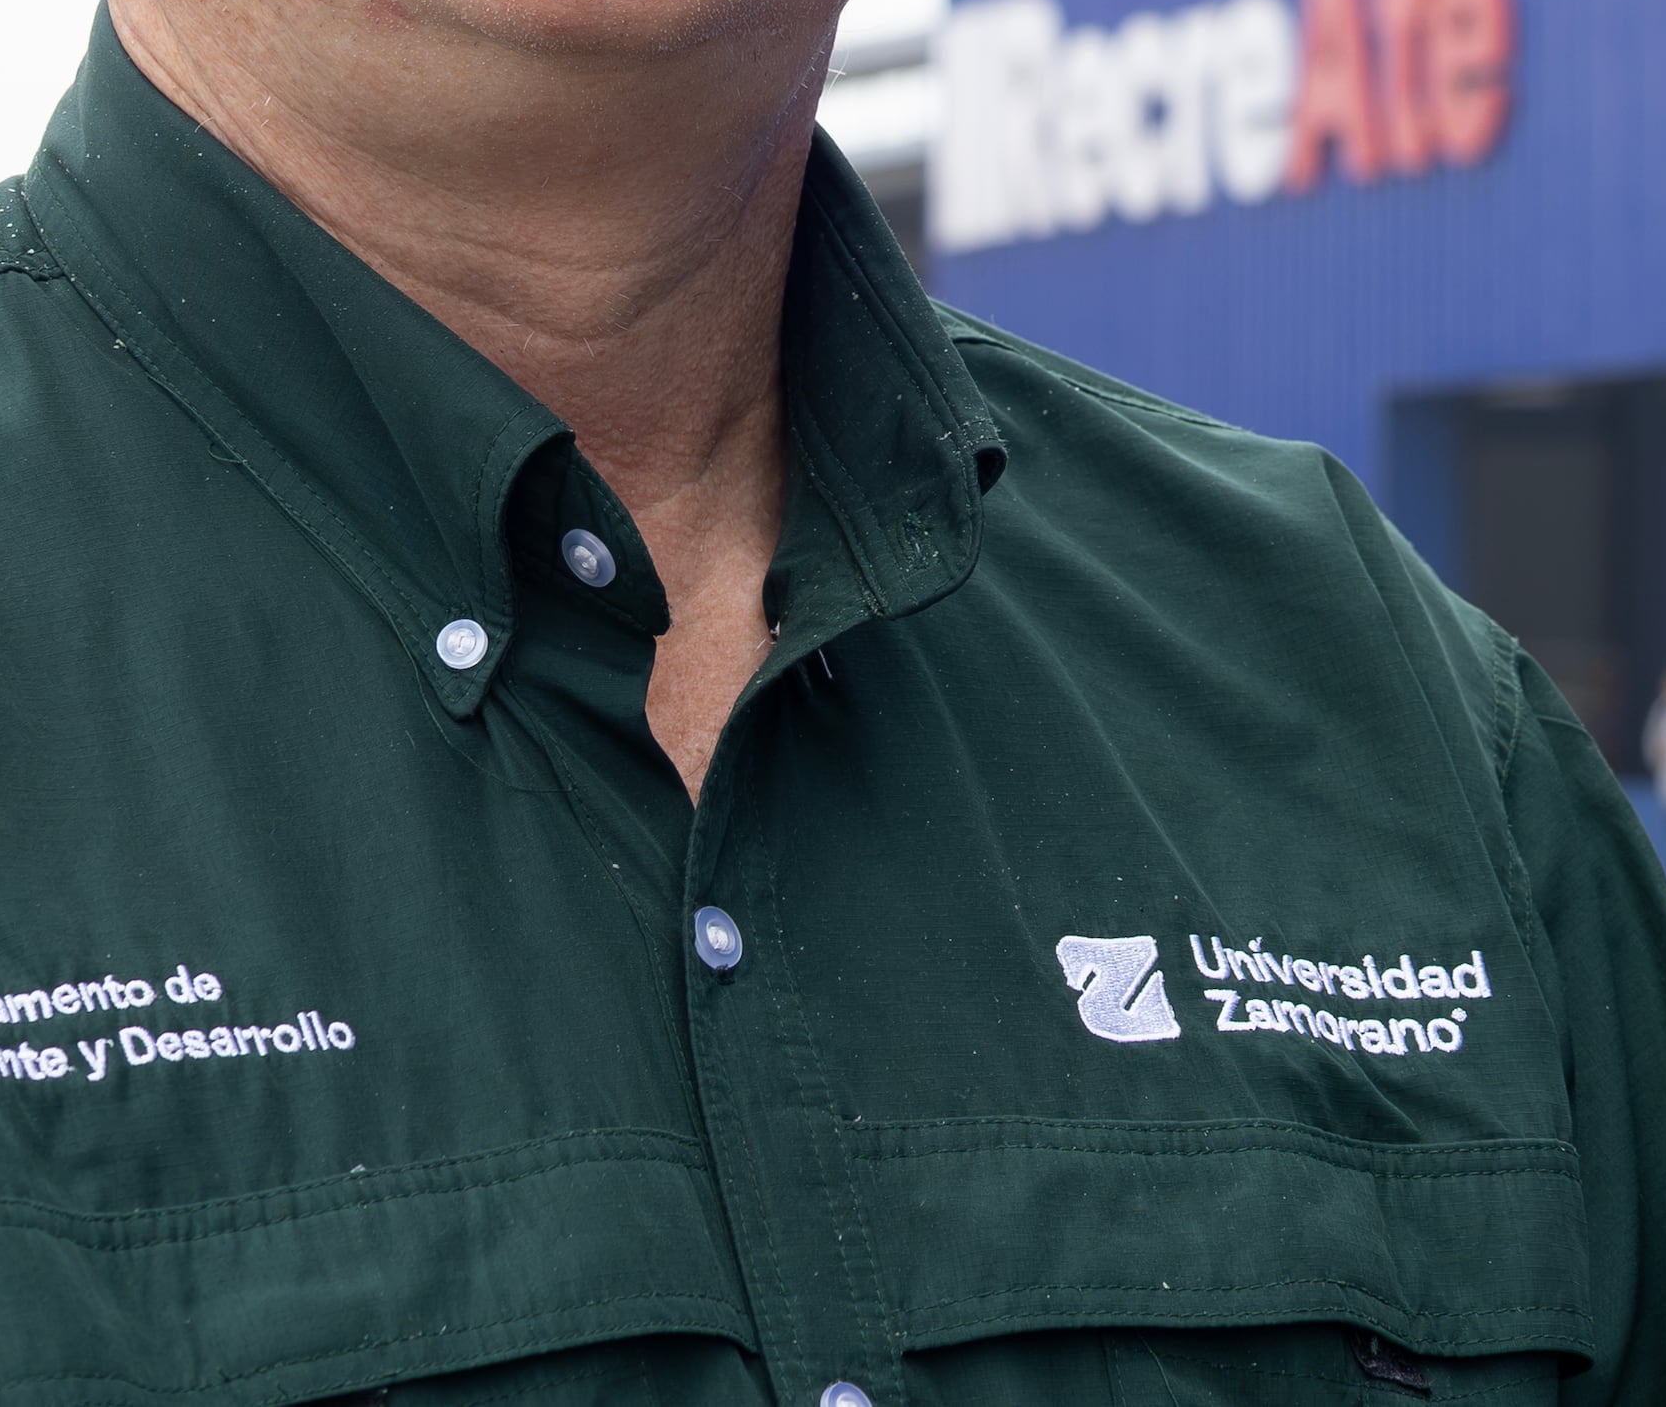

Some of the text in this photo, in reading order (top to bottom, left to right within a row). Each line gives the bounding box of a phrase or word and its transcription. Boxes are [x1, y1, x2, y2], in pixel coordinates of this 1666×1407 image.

[164, 964, 222, 1004] de
[1189, 934, 1492, 1000] Universidad
[77, 1038, 114, 1082] y
[118, 1010, 355, 1066] Desarrollo
